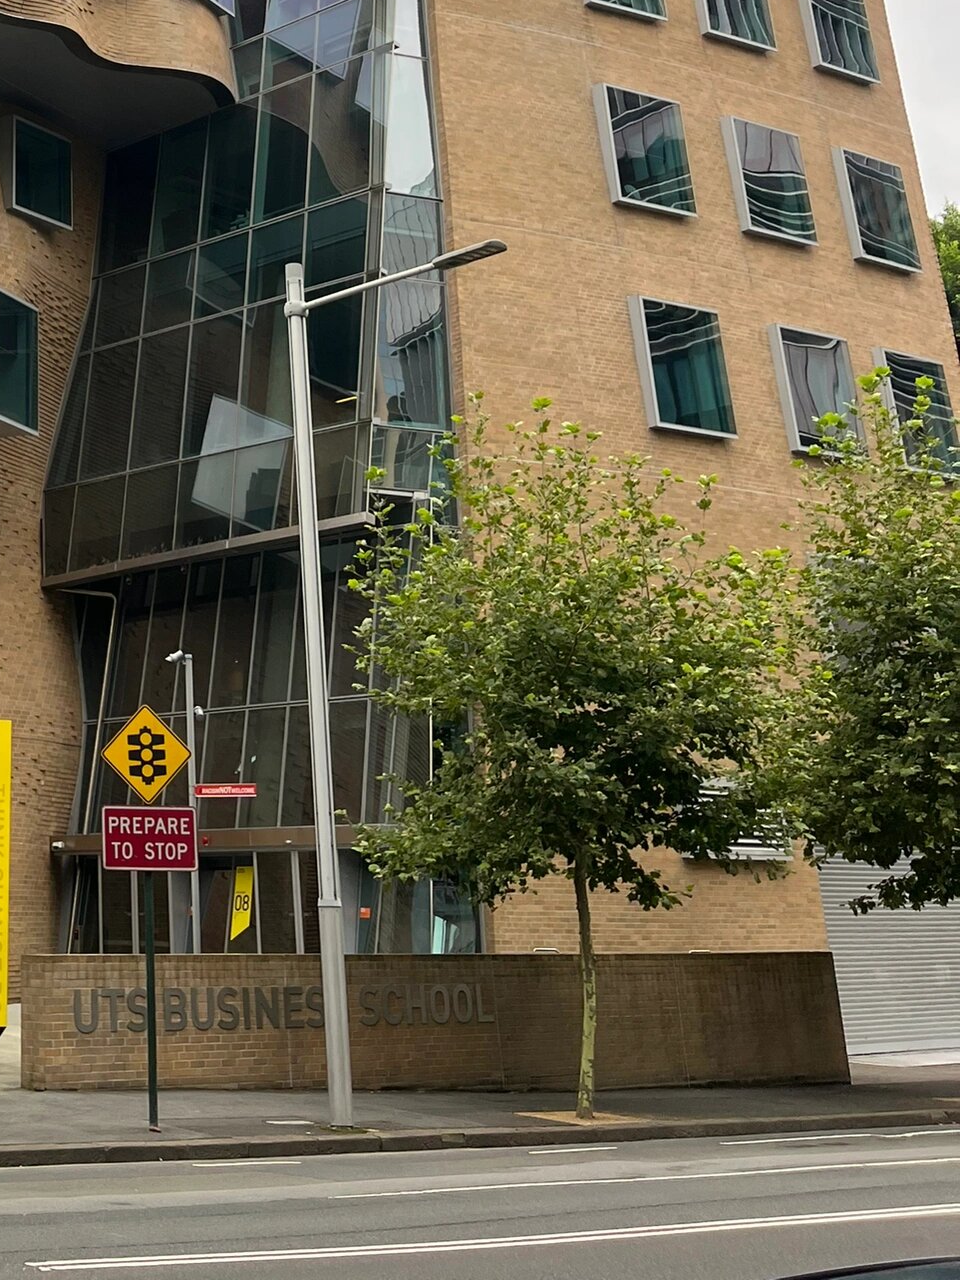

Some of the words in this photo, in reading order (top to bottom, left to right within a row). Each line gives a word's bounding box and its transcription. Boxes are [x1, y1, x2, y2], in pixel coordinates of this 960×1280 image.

[108, 816, 190, 835] PREPARE
[111, 842, 133, 859] TO
[144, 842, 188, 860] STOP
[235, 895, 249, 911] 08
[73, 987, 147, 1034] UTS
[163, 986, 325, 1032] BUSINES
[359, 983, 494, 1027] SCHOOL
